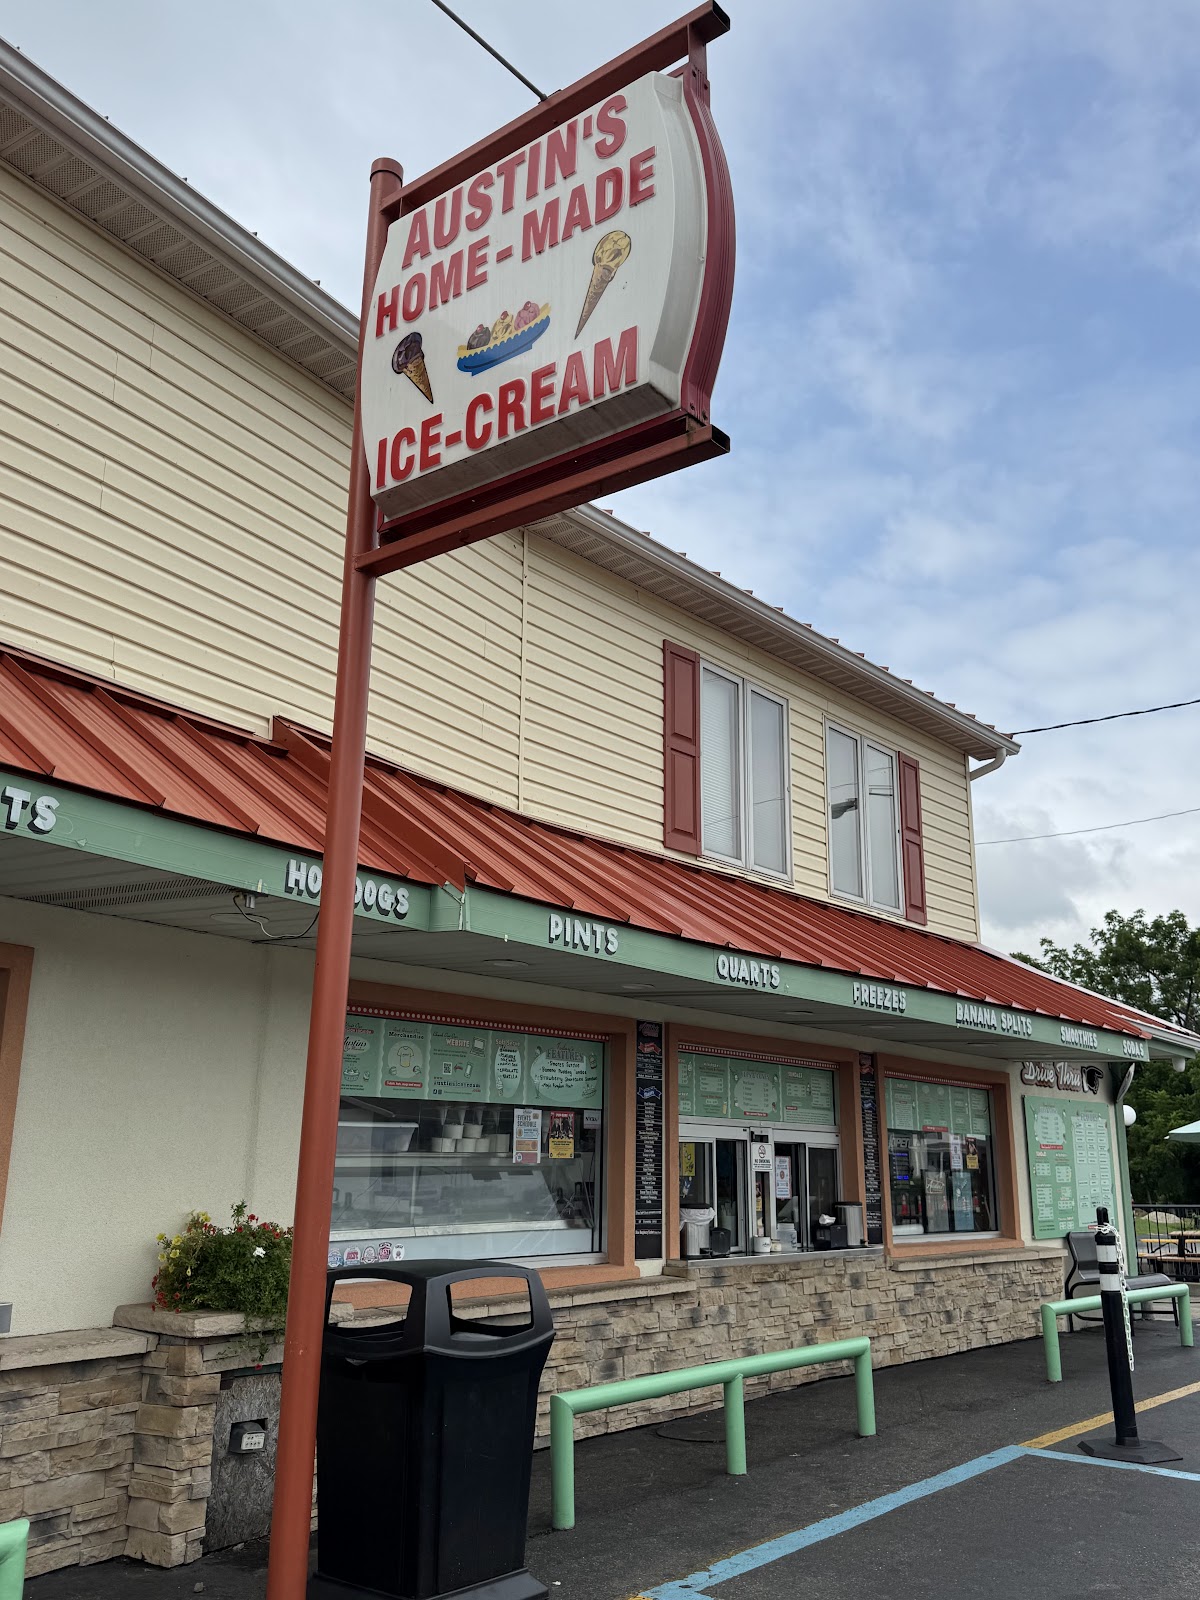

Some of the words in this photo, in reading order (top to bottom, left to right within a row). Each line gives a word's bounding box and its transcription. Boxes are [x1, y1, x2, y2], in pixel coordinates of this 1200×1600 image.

[402, 94, 628, 270] AUSTIN'S
[375, 146, 656, 339] HOME-MADE
[376, 325, 639, 490] ICE-CREAM
[285, 859, 323, 897] HO
[548, 914, 619, 954] PINTS
[717, 955, 780, 990] QUARTS
[853, 982, 907, 1013] FREEZES
[956, 1002, 998, 1030] BANANA
[1001, 1012, 1033, 1037] SPLITS
[388, 1031, 424, 1040] Merchandise
[446, 1038, 470, 1049] WEBSITE
[1060, 1025, 1099, 1051] SMOOTHIES
[1122, 1038, 1145, 1059] SODAS
[546, 1049, 584, 1062] FEATURES
[1023, 1062, 1056, 1086] Drive
[1056, 1062, 1082, 1090] Thru
[517, 1114, 532, 1122] EVENTS
[517, 1120, 537, 1128] SCHEDULE
